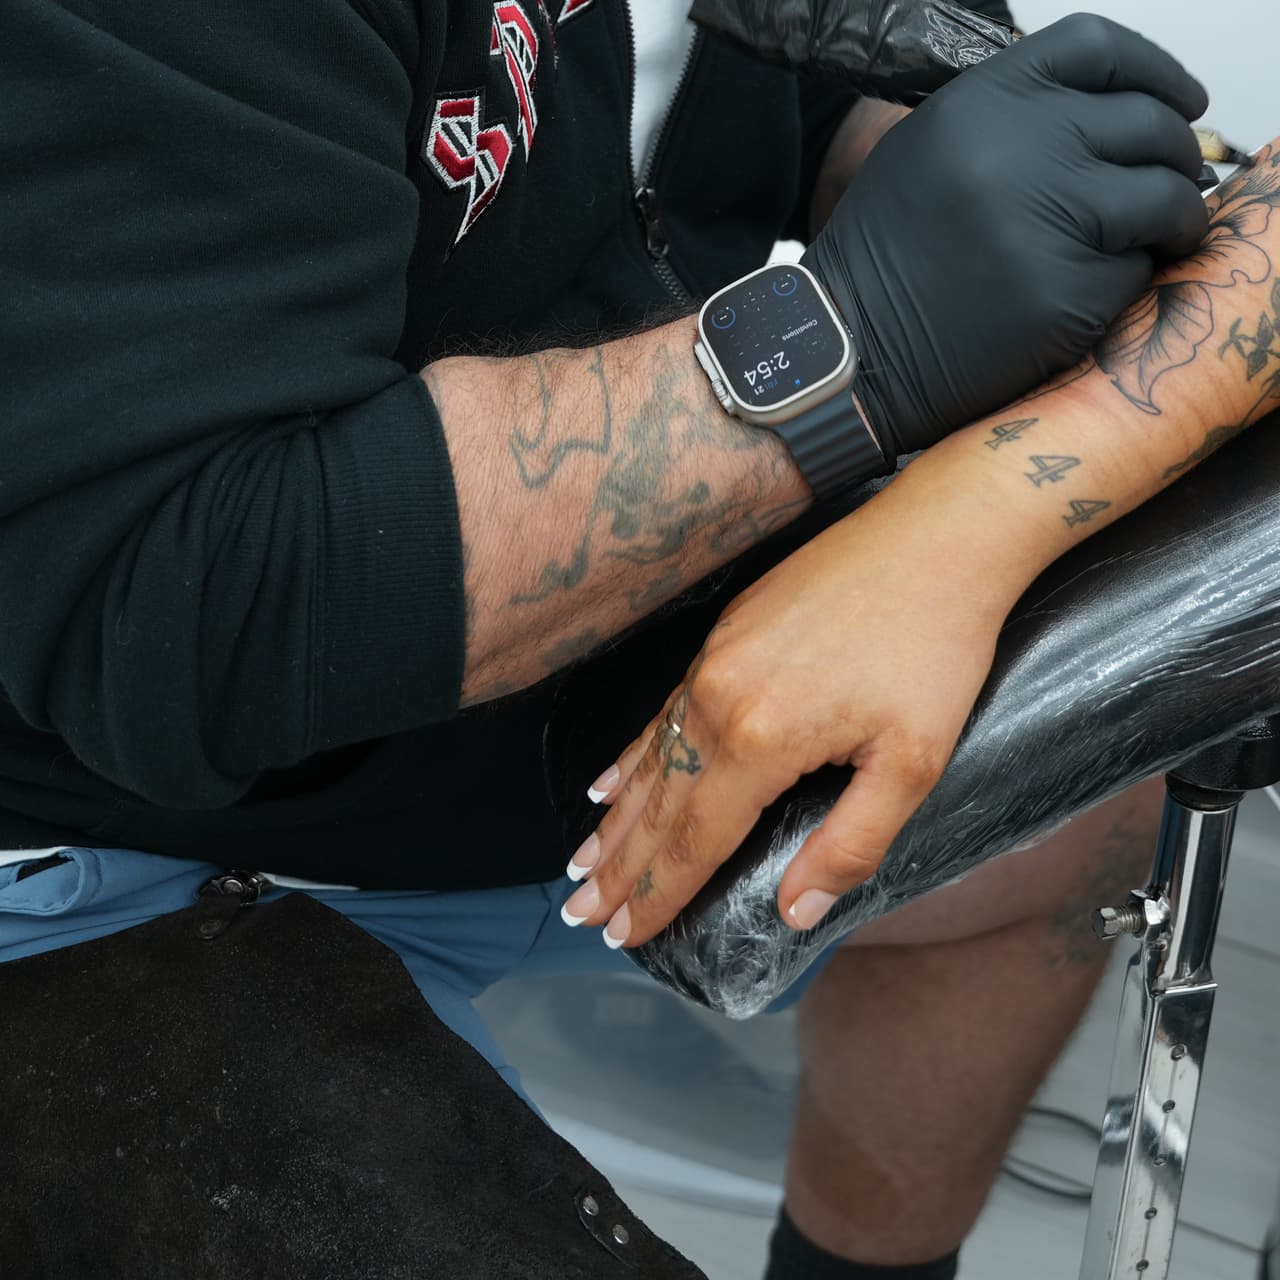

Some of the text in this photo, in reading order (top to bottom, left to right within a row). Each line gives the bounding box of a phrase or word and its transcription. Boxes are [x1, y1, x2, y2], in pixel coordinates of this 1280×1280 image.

[781, 318, 819, 342] Conditions
[742, 351, 791, 388] 2:54
[753, 385, 765, 397] 21
[984, 417, 1112, 529] 4 4 4
